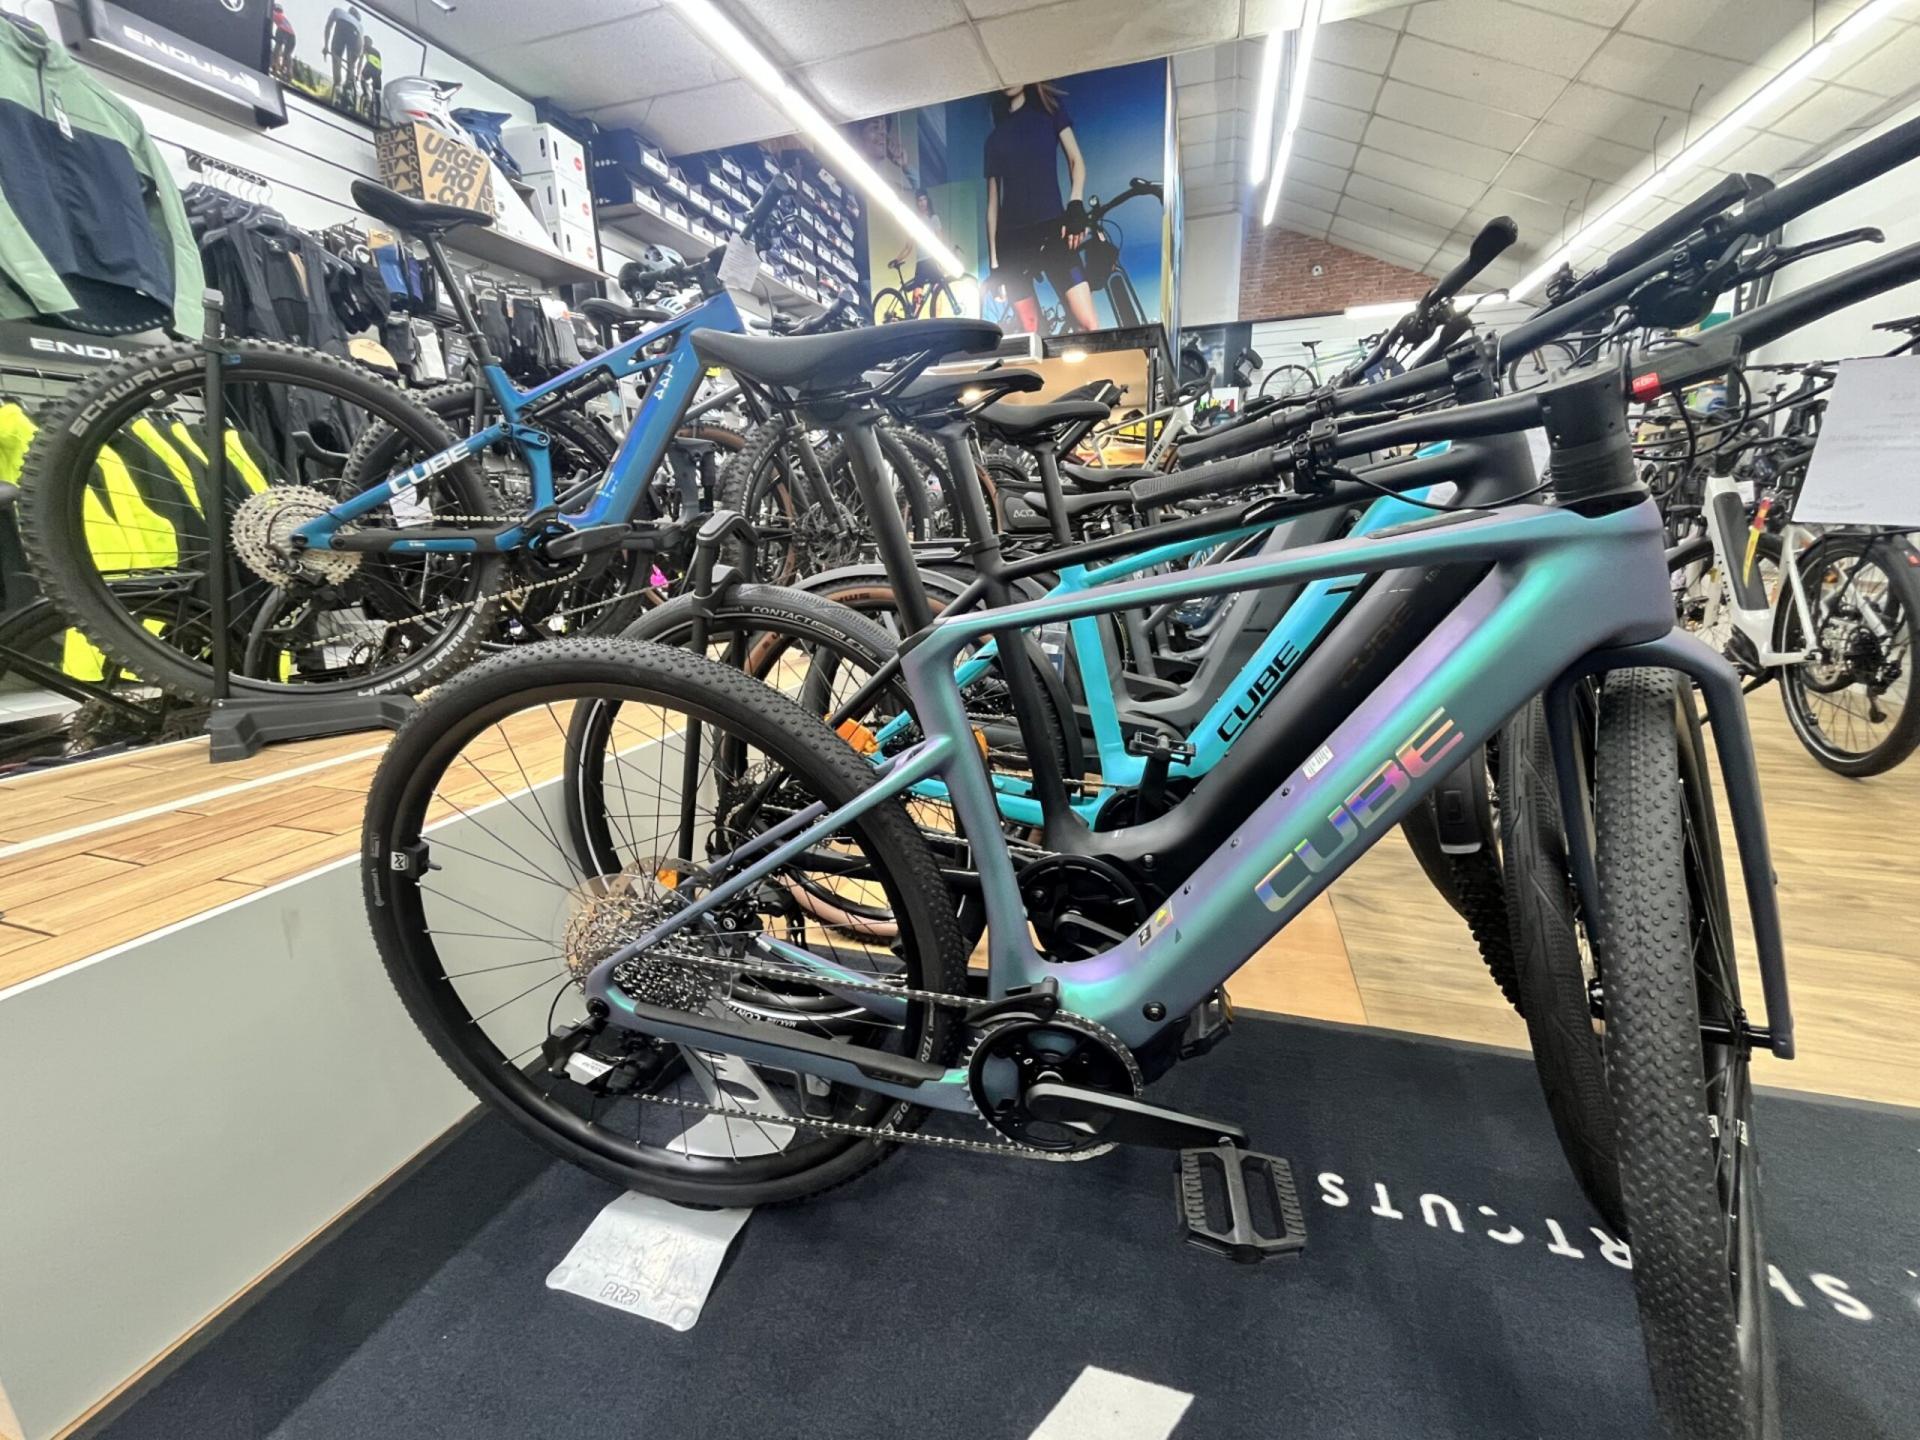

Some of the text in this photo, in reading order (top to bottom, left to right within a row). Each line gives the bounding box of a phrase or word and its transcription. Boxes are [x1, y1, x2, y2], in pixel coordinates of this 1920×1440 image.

[123, 26, 254, 93] ENDURA
[423, 133, 483, 176] URGE
[428, 159, 475, 192] PRO
[388, 442, 471, 494] CUBE
[752, 605, 812, 624] CONTACT
[1217, 639, 1300, 742] CUBE
[1254, 706, 1464, 912] CUBE
